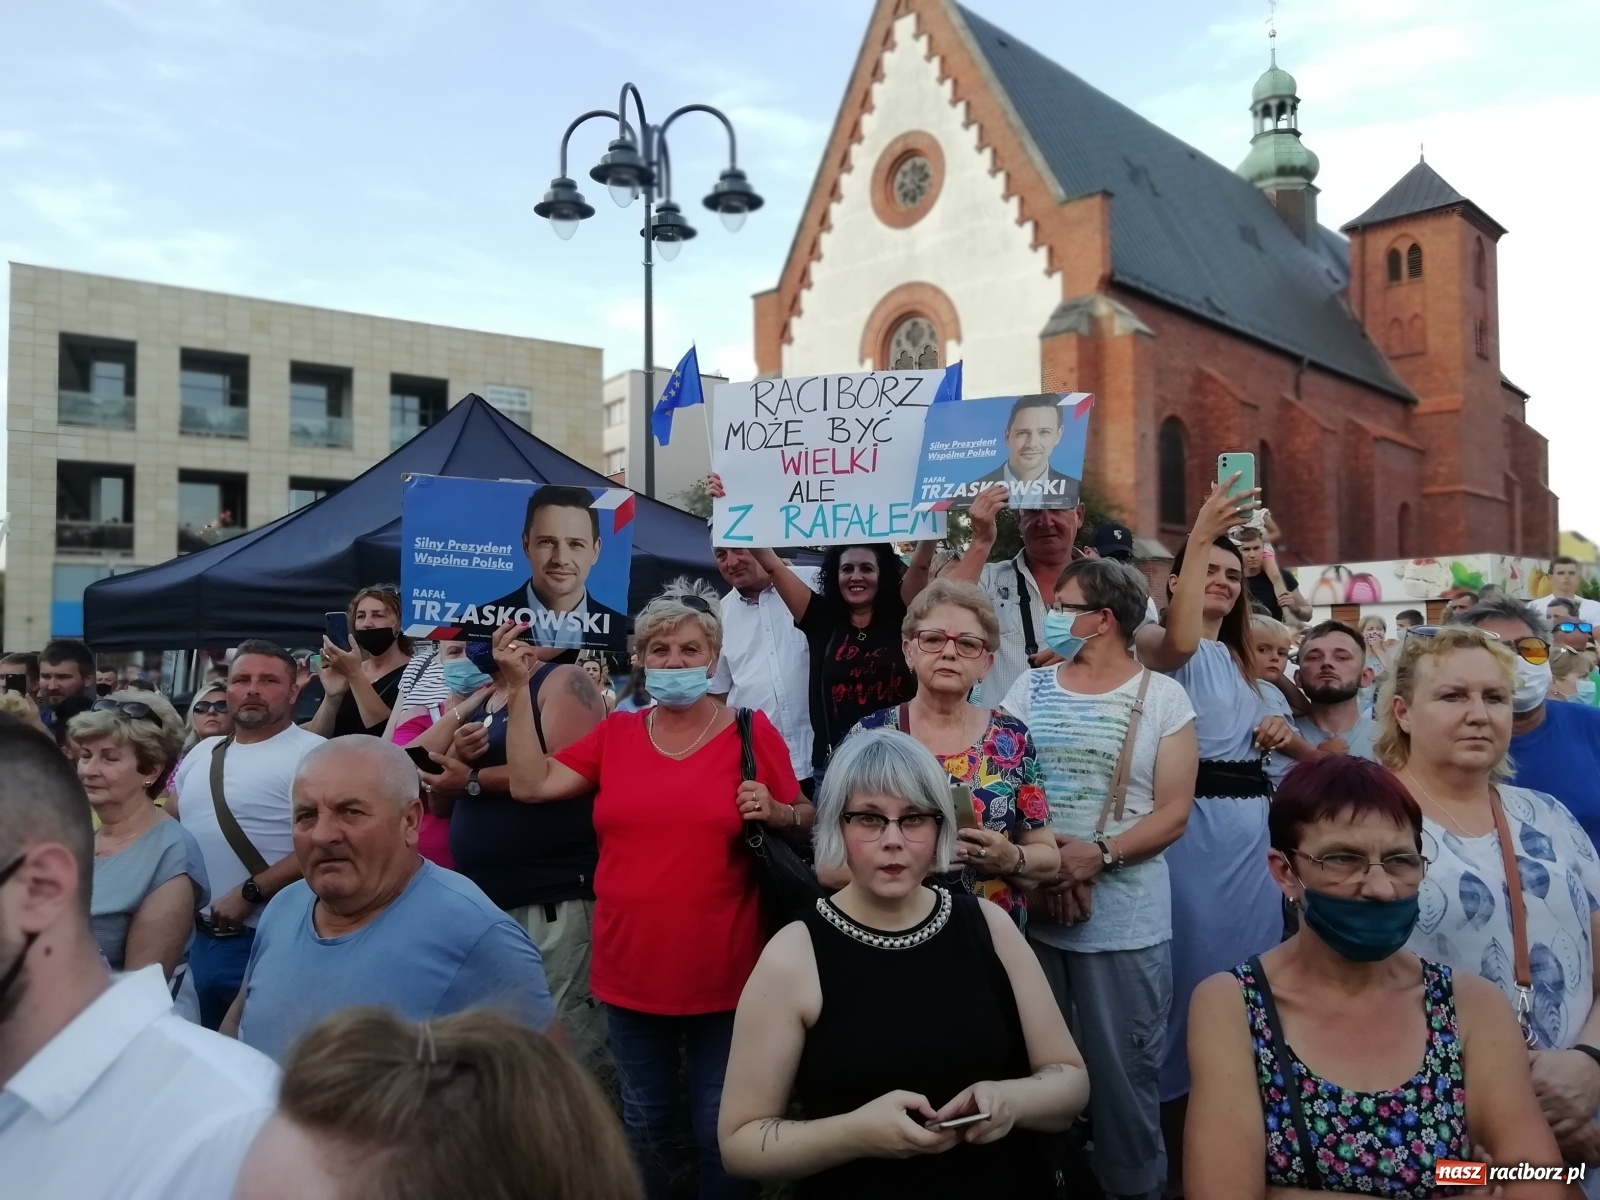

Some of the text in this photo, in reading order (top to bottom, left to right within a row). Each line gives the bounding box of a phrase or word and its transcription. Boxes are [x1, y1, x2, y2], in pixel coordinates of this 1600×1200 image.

[750, 372, 930, 418] RACIBÓRZ
[724, 410, 893, 451] MOŻE BYĆ
[929, 438, 997, 451] Silny Prezydent
[928, 449, 997, 461] Wspólna Polska
[923, 476, 946, 484] RAFAŁ
[788, 479, 836, 503] ALE
[722, 502, 938, 541] Z RAFAŁEM
[414, 537, 513, 555] Silny Prezydent
[414, 552, 514, 570] Wspólna Polska
[412, 588, 447, 600] RAFAŁ
[412, 600, 611, 634] TRZASKOWSKI
